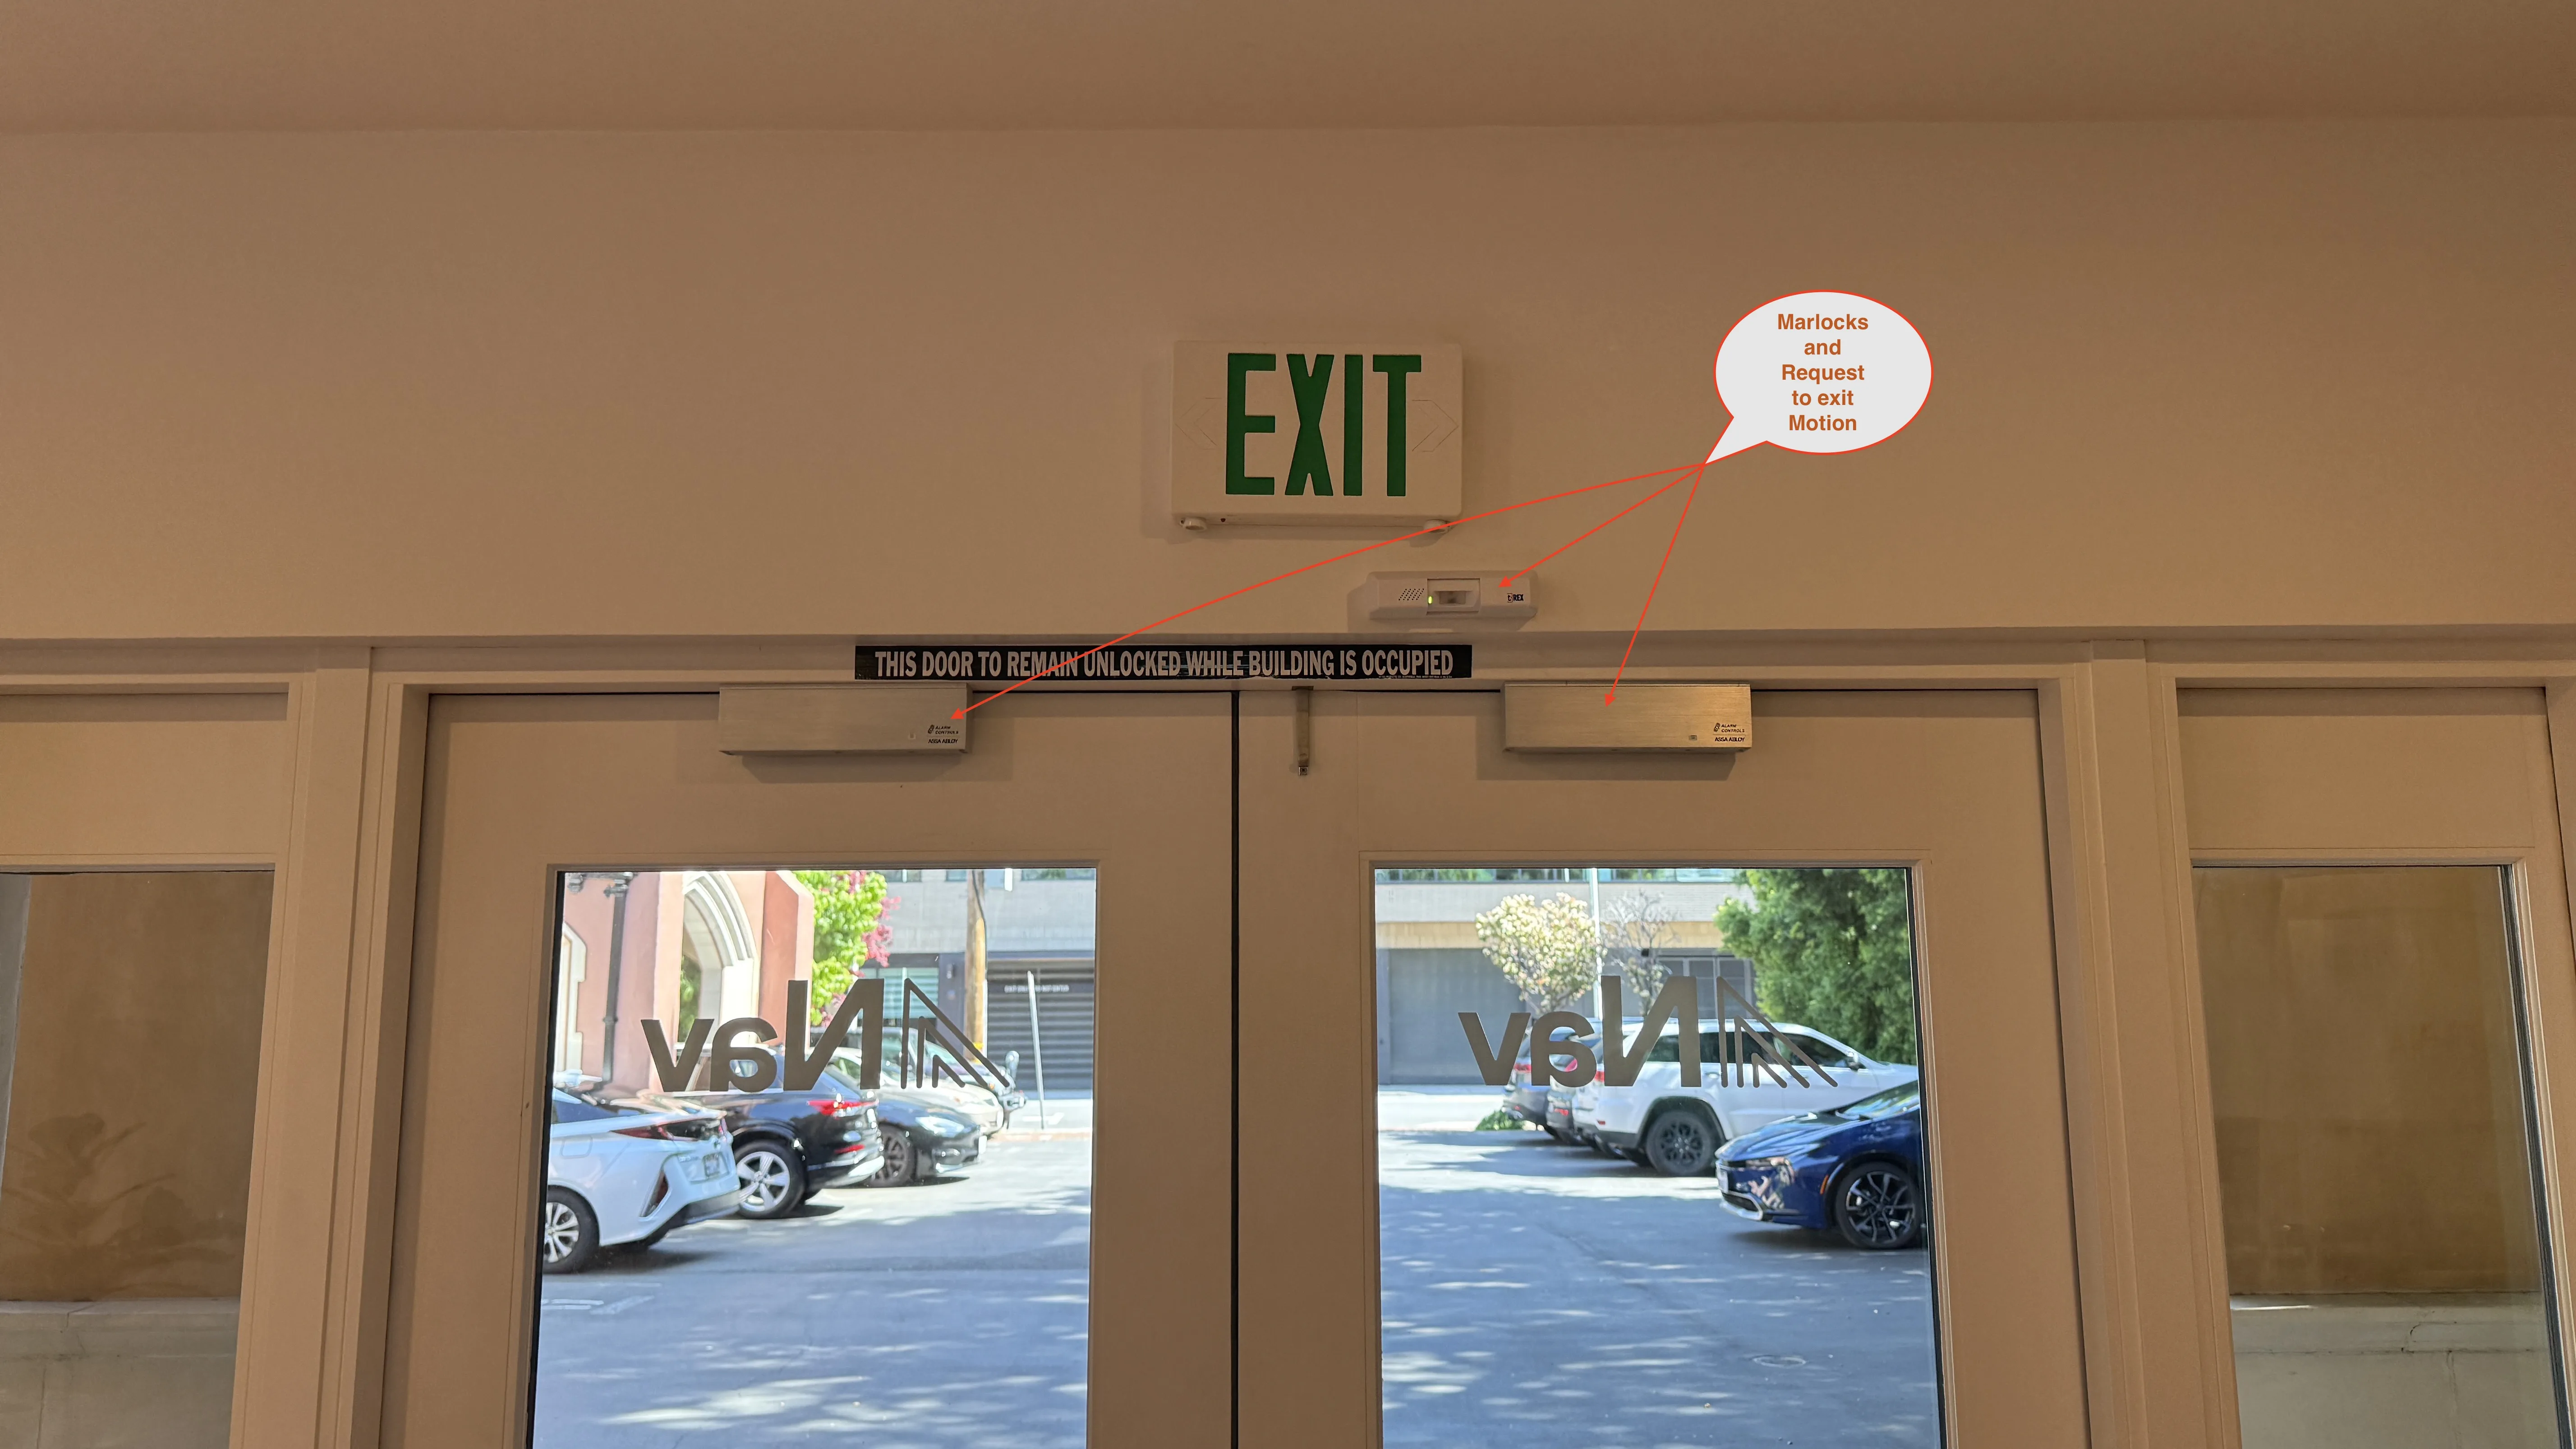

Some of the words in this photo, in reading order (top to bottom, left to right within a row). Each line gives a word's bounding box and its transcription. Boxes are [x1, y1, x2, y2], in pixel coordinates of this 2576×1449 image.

[1226, 353, 1421, 496] EXIT
[875, 651, 916, 676] THIS
[922, 651, 974, 676] DOOR
[978, 651, 1002, 676] TO
[1007, 651, 1078, 676] REMAIN
[1084, 650, 1181, 676] UNLOCKED
[1185, 650, 1244, 676] WHILE
[1249, 650, 1334, 676] BUILDING
[1340, 650, 1357, 676] IS
[1362, 650, 1453, 676] OCCUPIED
